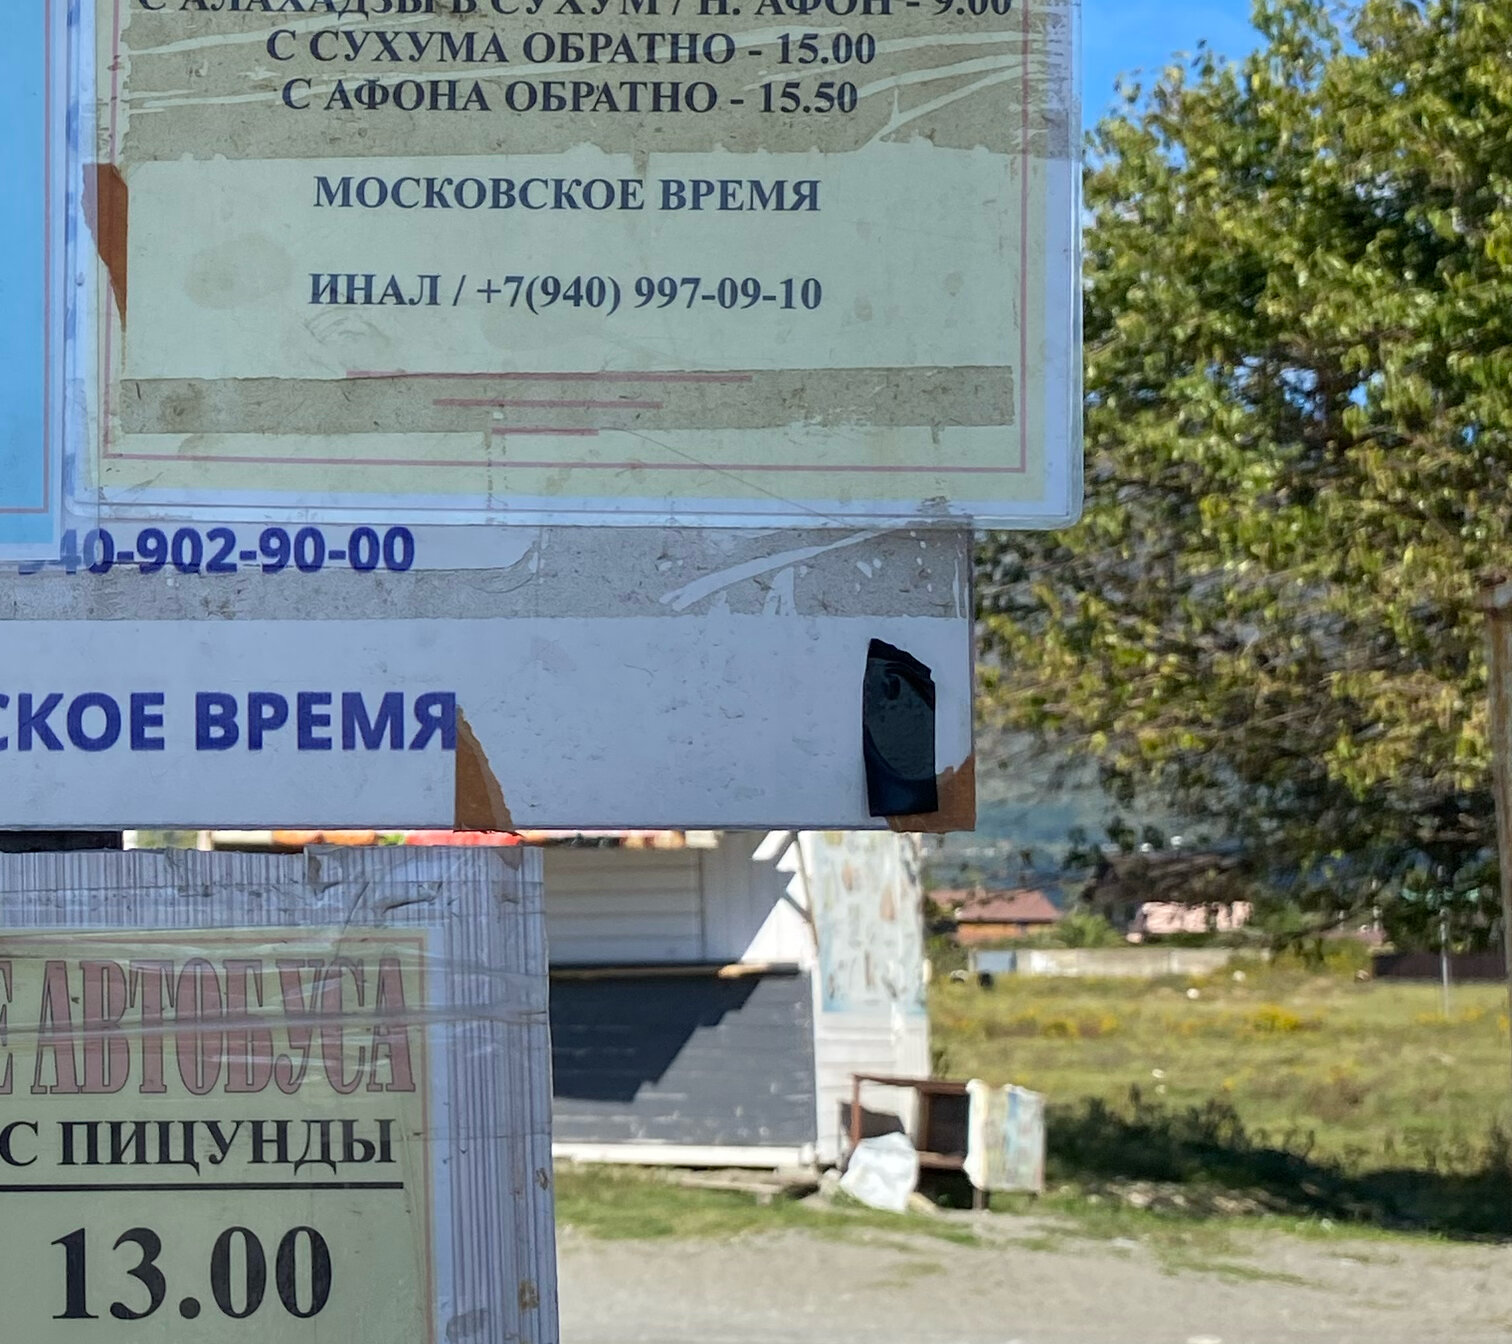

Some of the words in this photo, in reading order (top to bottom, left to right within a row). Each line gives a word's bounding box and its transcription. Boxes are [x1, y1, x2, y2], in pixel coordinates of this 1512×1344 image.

[267, 30, 296, 60] С
[310, 30, 509, 62] СУХУМА
[523, 32, 735, 64] ОБРАТНО
[778, 33, 875, 64] 15.00
[282, 79, 312, 109] С
[324, 79, 491, 111] АФОНА
[505, 81, 717, 113] ОБРАТНО
[760, 82, 857, 113] 15.50
[314, 177, 644, 210] МОСКОВСКОЕ
[660, 180, 820, 211] ВРЕМЯ
[310, 274, 440, 305] ИНАЛ
[453, 275, 466, 306] /
[477, 276, 620, 316] +7(940)
[635, 277, 821, 309] 997-09-10
[195, 691, 457, 751] ВРЕМЯ
[31, 956, 416, 1096] АВТОБУСА
[57, 1119, 396, 1175] ПИЦУНДЫ
[51, 1226, 332, 1320] 13.00
